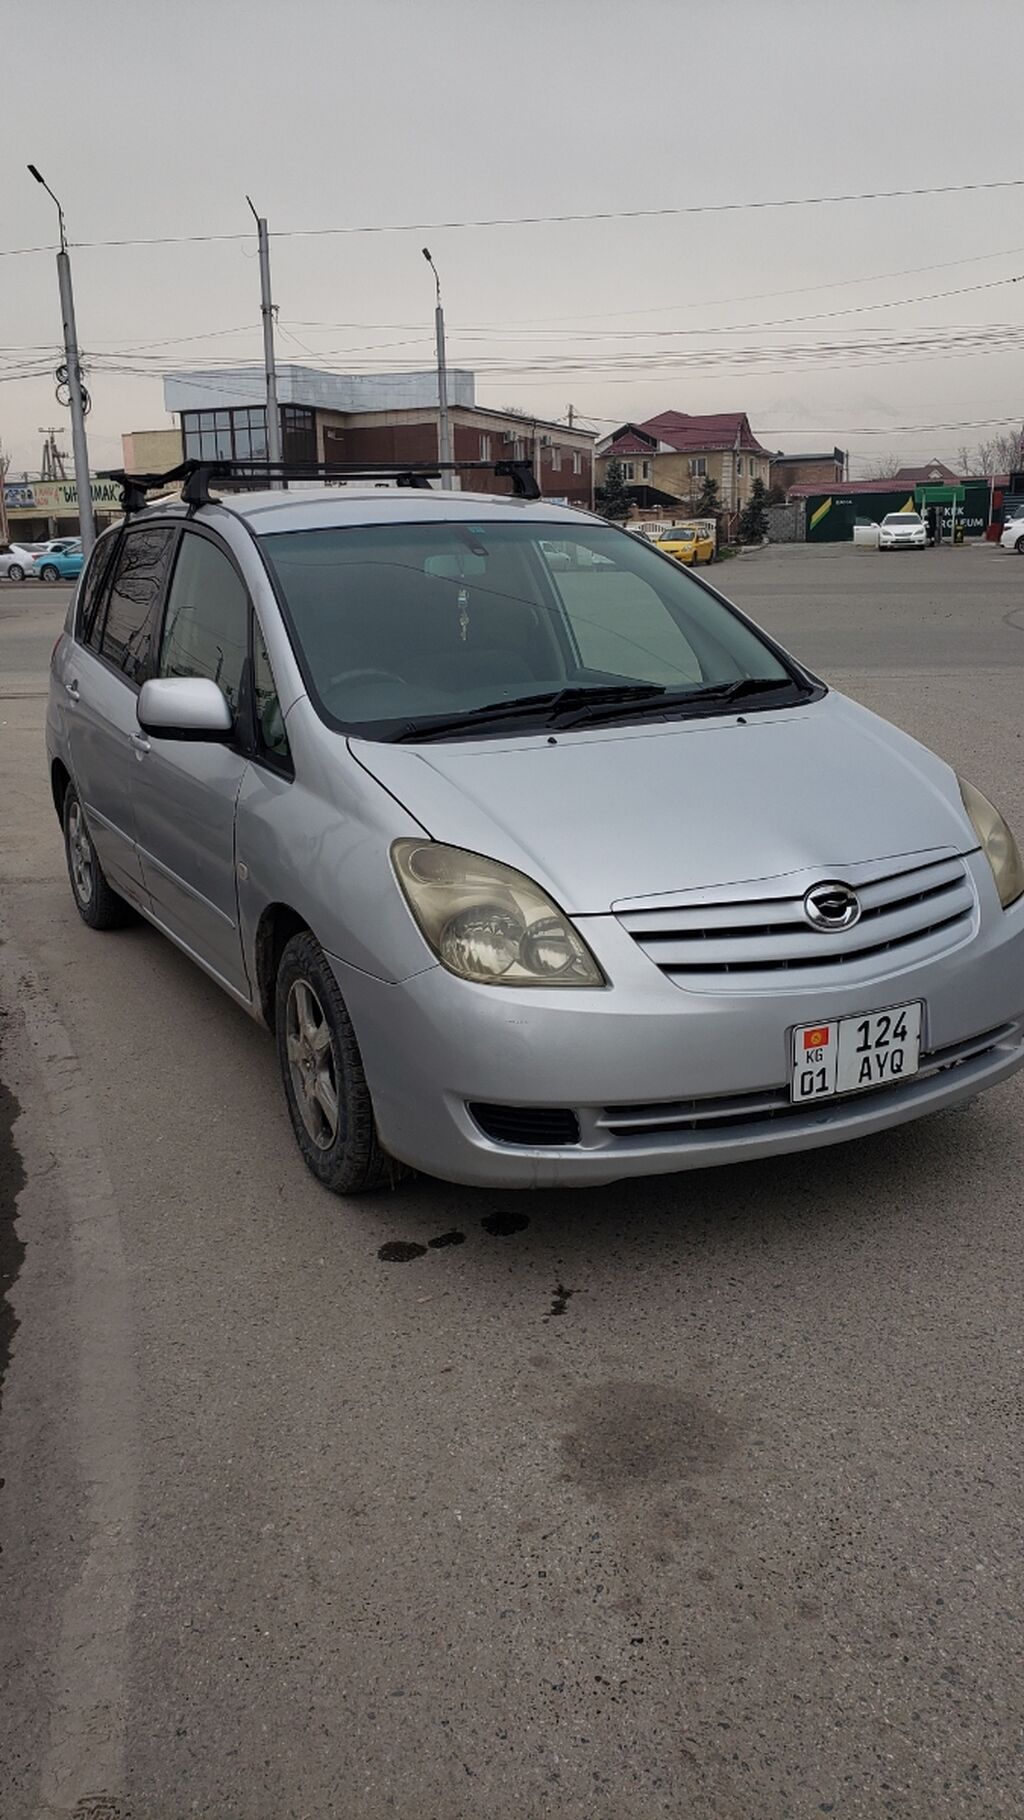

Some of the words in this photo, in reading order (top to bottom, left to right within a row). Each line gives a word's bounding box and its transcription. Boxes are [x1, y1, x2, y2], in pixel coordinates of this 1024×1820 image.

[856, 1011, 908, 1053] 124
[806, 1048, 823, 1064] KG
[858, 1049, 904, 1083] AYQ
[800, 1067, 829, 1096] 01
